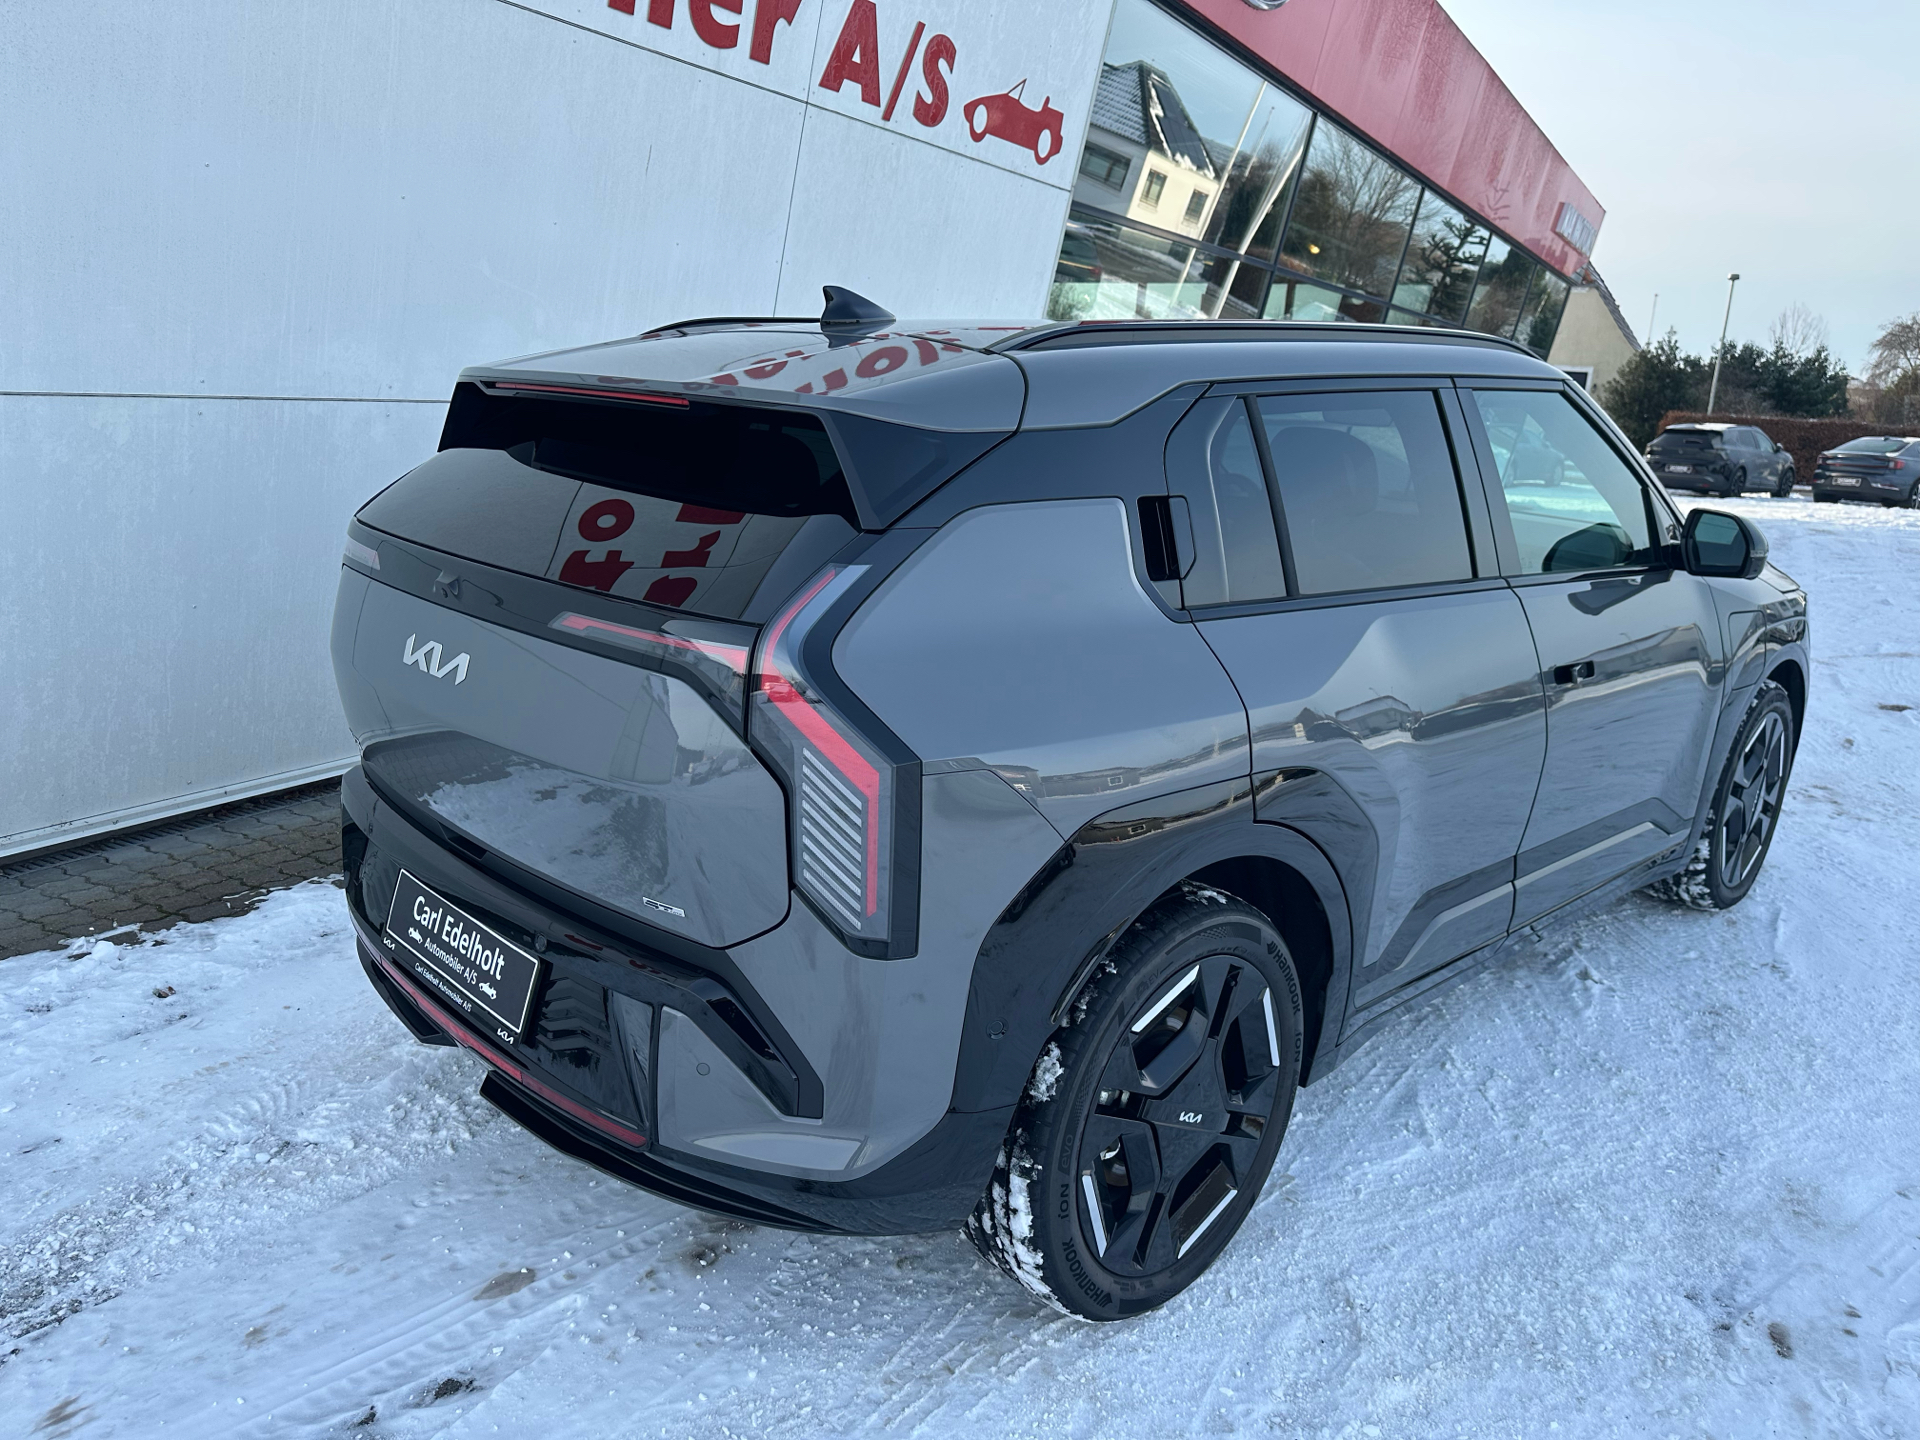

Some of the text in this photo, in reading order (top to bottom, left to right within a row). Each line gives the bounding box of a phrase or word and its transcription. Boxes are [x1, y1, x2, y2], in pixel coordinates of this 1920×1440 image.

[818, 0, 957, 128] A/S
[402, 632, 471, 686] KIA
[383, 937, 396, 951] KIA
[413, 895, 506, 981] Carl Edelholt
[424, 938, 478, 986] Automobiler A/S
[414, 962, 472, 1012] Carl Edelholt Automobiler A/S
[496, 1027, 514, 1045] KIA
[1178, 1110, 1203, 1124] KIA
